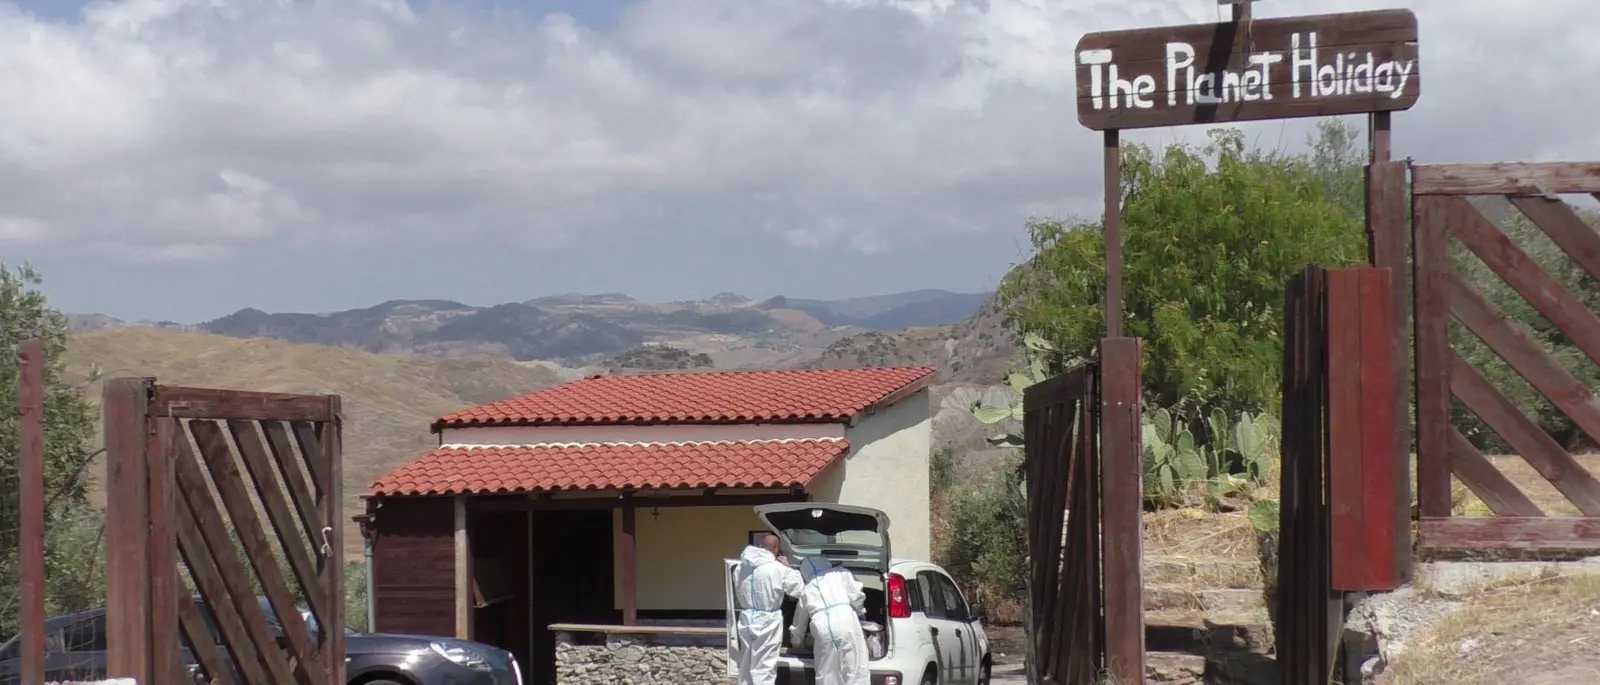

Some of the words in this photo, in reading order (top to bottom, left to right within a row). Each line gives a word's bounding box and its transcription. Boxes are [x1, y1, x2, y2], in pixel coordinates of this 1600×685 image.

[1079, 49, 1156, 110] The
[1166, 42, 1283, 107] Planet
[1291, 31, 1413, 99] Holiday
